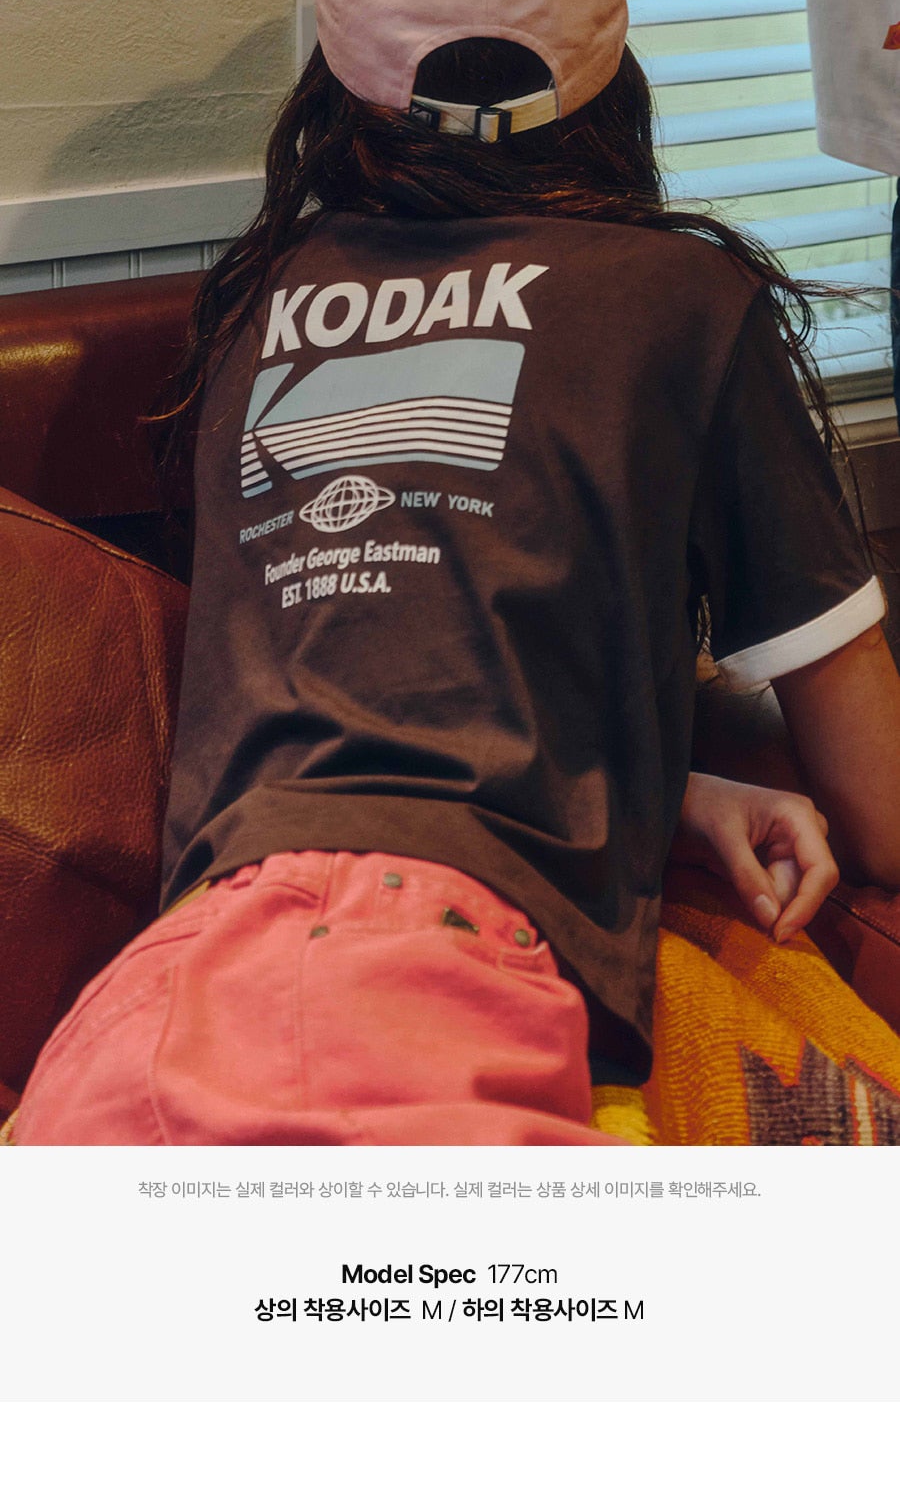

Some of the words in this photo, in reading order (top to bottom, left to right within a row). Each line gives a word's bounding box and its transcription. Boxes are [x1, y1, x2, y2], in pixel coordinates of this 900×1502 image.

[261, 262, 550, 359] KODAK
[239, 510, 295, 544] ROCHESTER
[400, 491, 442, 508] NEW
[448, 494, 495, 518] YORK
[265, 552, 306, 585] Founder
[306, 547, 360, 570] George
[363, 540, 441, 565] Eastman
[304, 573, 338, 601] 1888
[340, 571, 392, 595] U.S.A.
